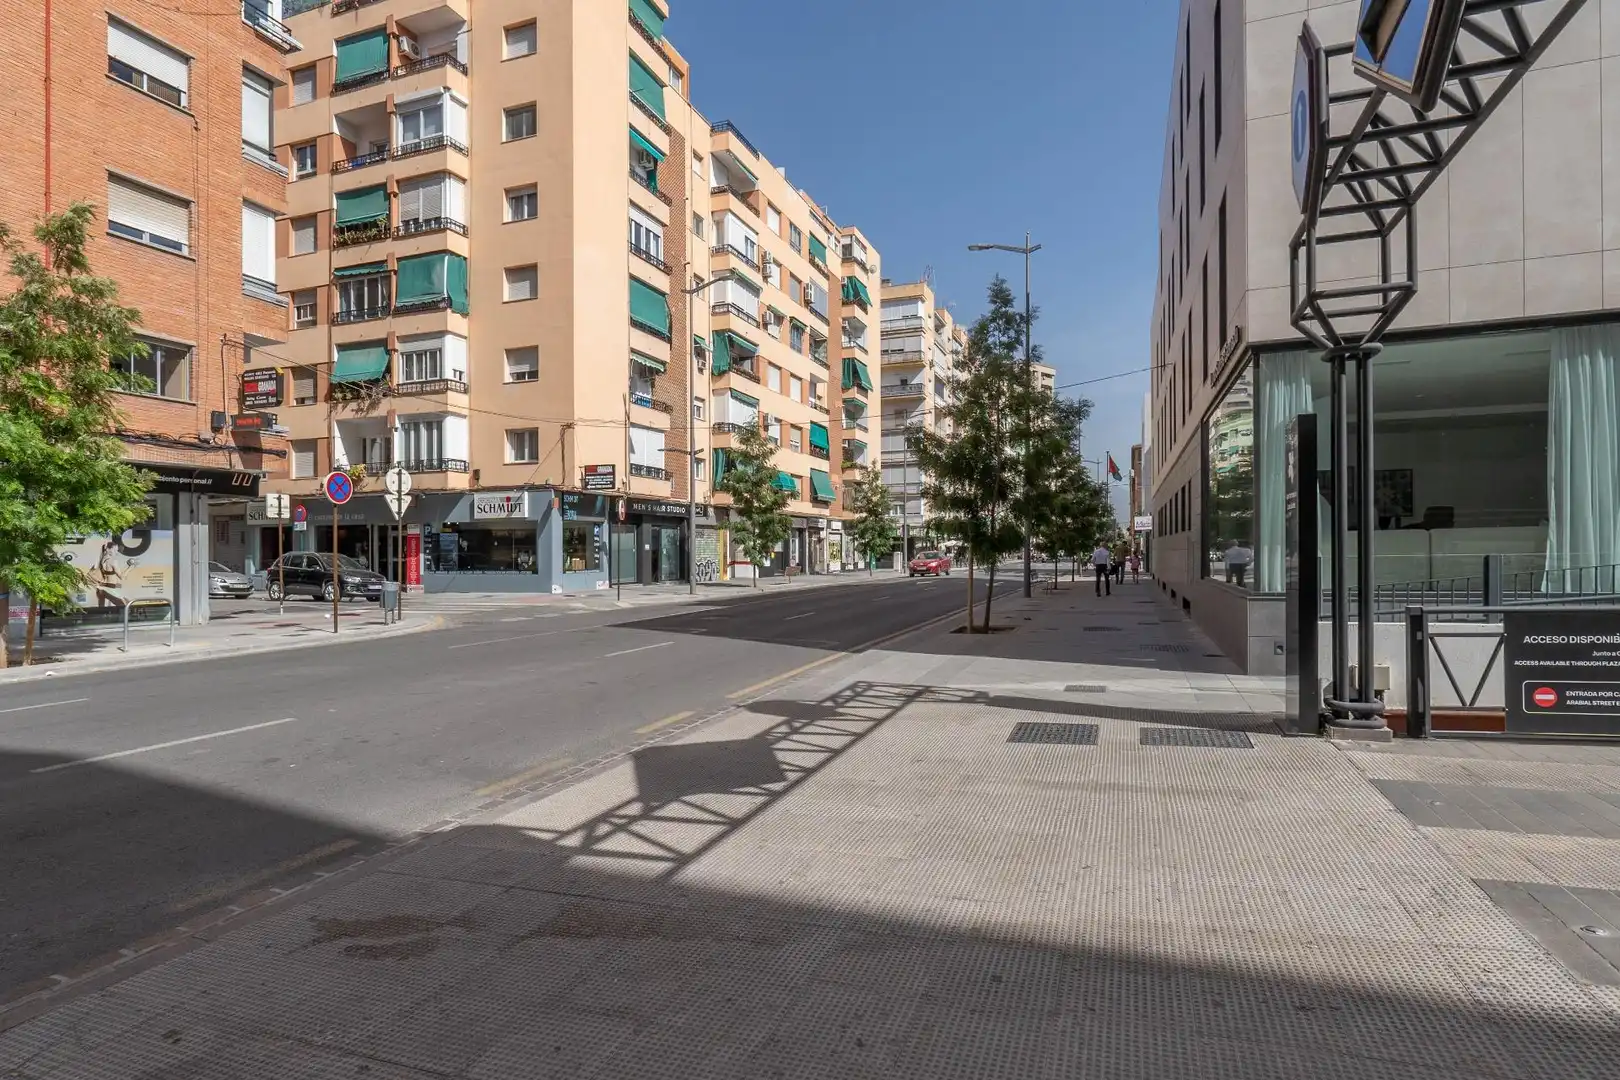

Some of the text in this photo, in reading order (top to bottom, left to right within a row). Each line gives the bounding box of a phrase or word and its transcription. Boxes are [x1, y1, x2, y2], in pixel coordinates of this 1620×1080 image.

[180, 477, 206, 485] peronal
[666, 505, 686, 514] STUDIO
[1523, 635, 1620, 644] ACCESO DISPONIB
